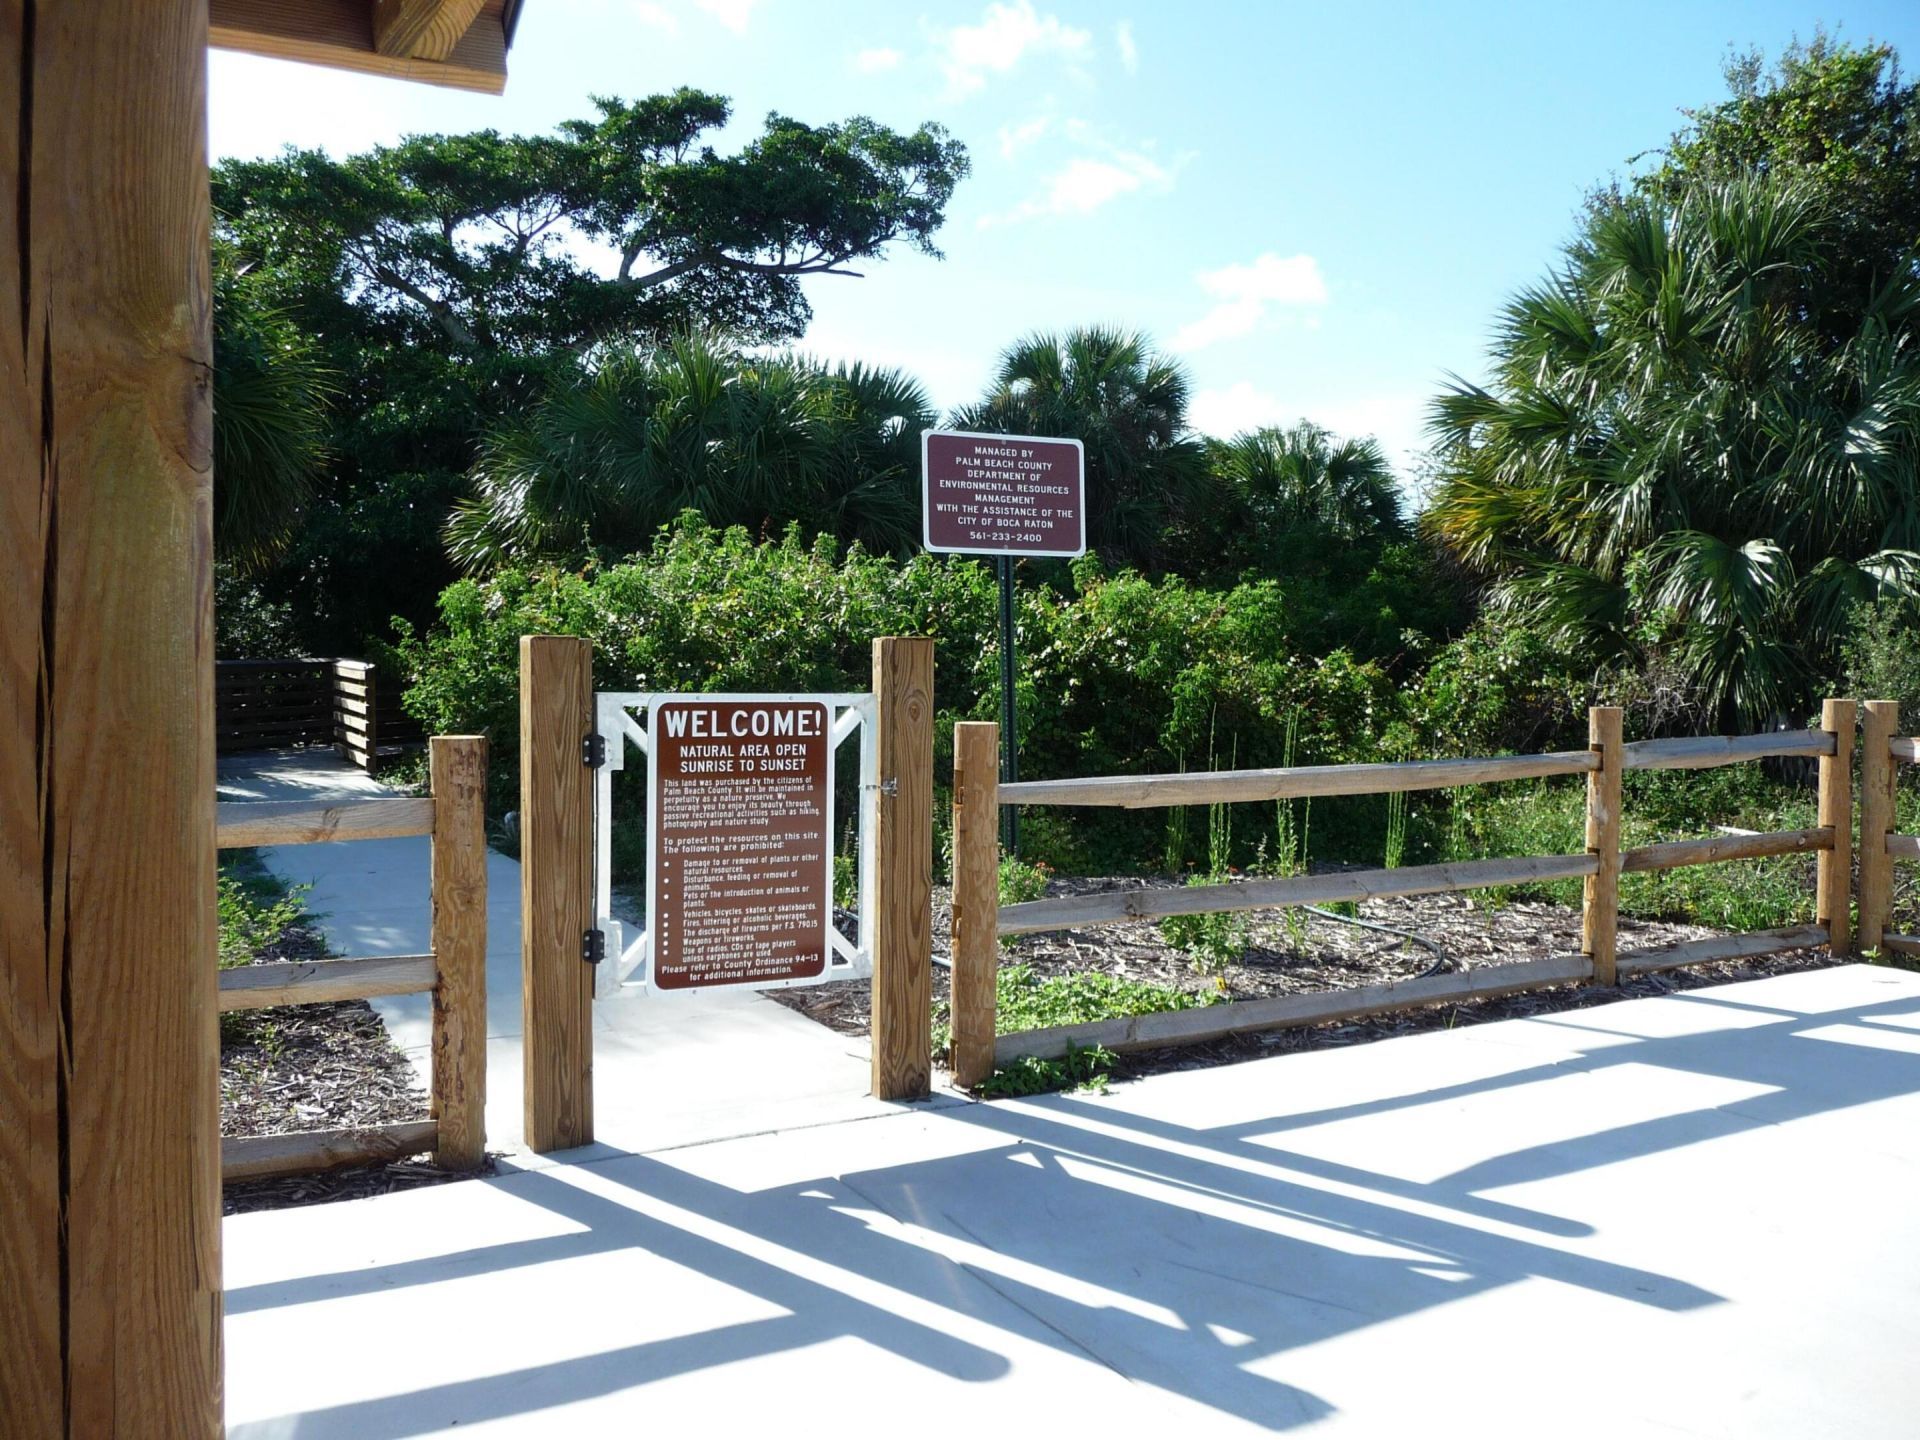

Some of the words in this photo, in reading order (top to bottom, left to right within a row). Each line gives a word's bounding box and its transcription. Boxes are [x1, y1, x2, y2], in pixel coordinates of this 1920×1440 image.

[975, 446, 1017, 457] MANAGED
[1022, 450, 1033, 458] BY
[956, 457, 981, 466] PALM
[985, 459, 1014, 468] BEACH
[1018, 461, 1052, 471] COUNTY
[967, 470, 1025, 480] DEPARTMENT
[1030, 473, 1042, 481] OF
[940, 480, 1013, 492] ENVIRONMENTAL
[1017, 485, 1069, 495] RESOURCES
[975, 494, 1035, 505] MANAGEMENT
[936, 504, 958, 512] WITH
[962, 505, 979, 514] THE
[983, 506, 1037, 516] ASSISTANCE
[1041, 509, 1053, 517] OF
[1057, 510, 1073, 518] THE
[958, 517, 977, 525] CITY
[981, 518, 993, 526] OF
[997, 519, 1020, 527] BOCA
[1024, 520, 1053, 529] RATON
[970, 531, 1042, 542] 561-233-2400
[665, 710, 821, 738] WELCOME!
[680, 745, 734, 758] NATURAL
[739, 745, 770, 756] AREA
[776, 744, 806, 755] OPEN
[680, 760, 734, 773] SUNRISE
[740, 760, 754, 771] TO
[760, 759, 806, 771] SUNSET
[664, 779, 679, 787] This
[715, 778, 750, 786] purchased
[752, 777, 761, 787] by
[777, 776, 803, 784] citizens
[684, 786, 705, 794] Beach
[769, 784, 805, 792] maintained
[664, 796, 700, 805] perpetuity
[664, 804, 700, 812] encourage
[702, 803, 715, 812] you
[761, 801, 783, 810] beauty
[786, 800, 811, 808] through
[664, 813, 689, 821] passive
[692, 811, 734, 819] recreational
[737, 809, 768, 817] activities
[664, 820, 708, 831] photography
[677, 836, 708, 847] protect
[729, 834, 768, 843] resources
[785, 832, 800, 840] this
[664, 846, 679, 854] The
[682, 845, 720, 853] following
[684, 859, 710, 868] Damage
[732, 856, 759, 864] removal
[770, 855, 790, 864] plants
[727, 874, 751, 882] feeding
[763, 870, 789, 879] removal
[724, 889, 764, 897] introduction
[766, 887, 773, 895] of
[775, 886, 800, 894] animals
[745, 906, 766, 914] skates
[703, 917, 730, 925] littering
[743, 914, 772, 923] alcoholic
[683, 929, 695, 937] The
[698, 927, 729, 936] discharge
[741, 924, 769, 932] firearms
[772, 924, 782, 932] per
[683, 937, 712, 947] Weapons
[683, 947, 695, 955] Use
[697, 946, 704, 954] of
[731, 943, 744, 951] CDs
[755, 941, 769, 950] tape
[772, 940, 796, 949] players
[682, 955, 704, 963] unless
[706, 952, 740, 961] earphones
[743, 950, 754, 958] are
[662, 965, 688, 974] Please
[691, 963, 709, 971] refer
[724, 960, 752, 969] County
[755, 957, 793, 966] Ordinance
[690, 973, 701, 981] for
[704, 969, 743, 980] additional
[746, 966, 792, 976] information.
